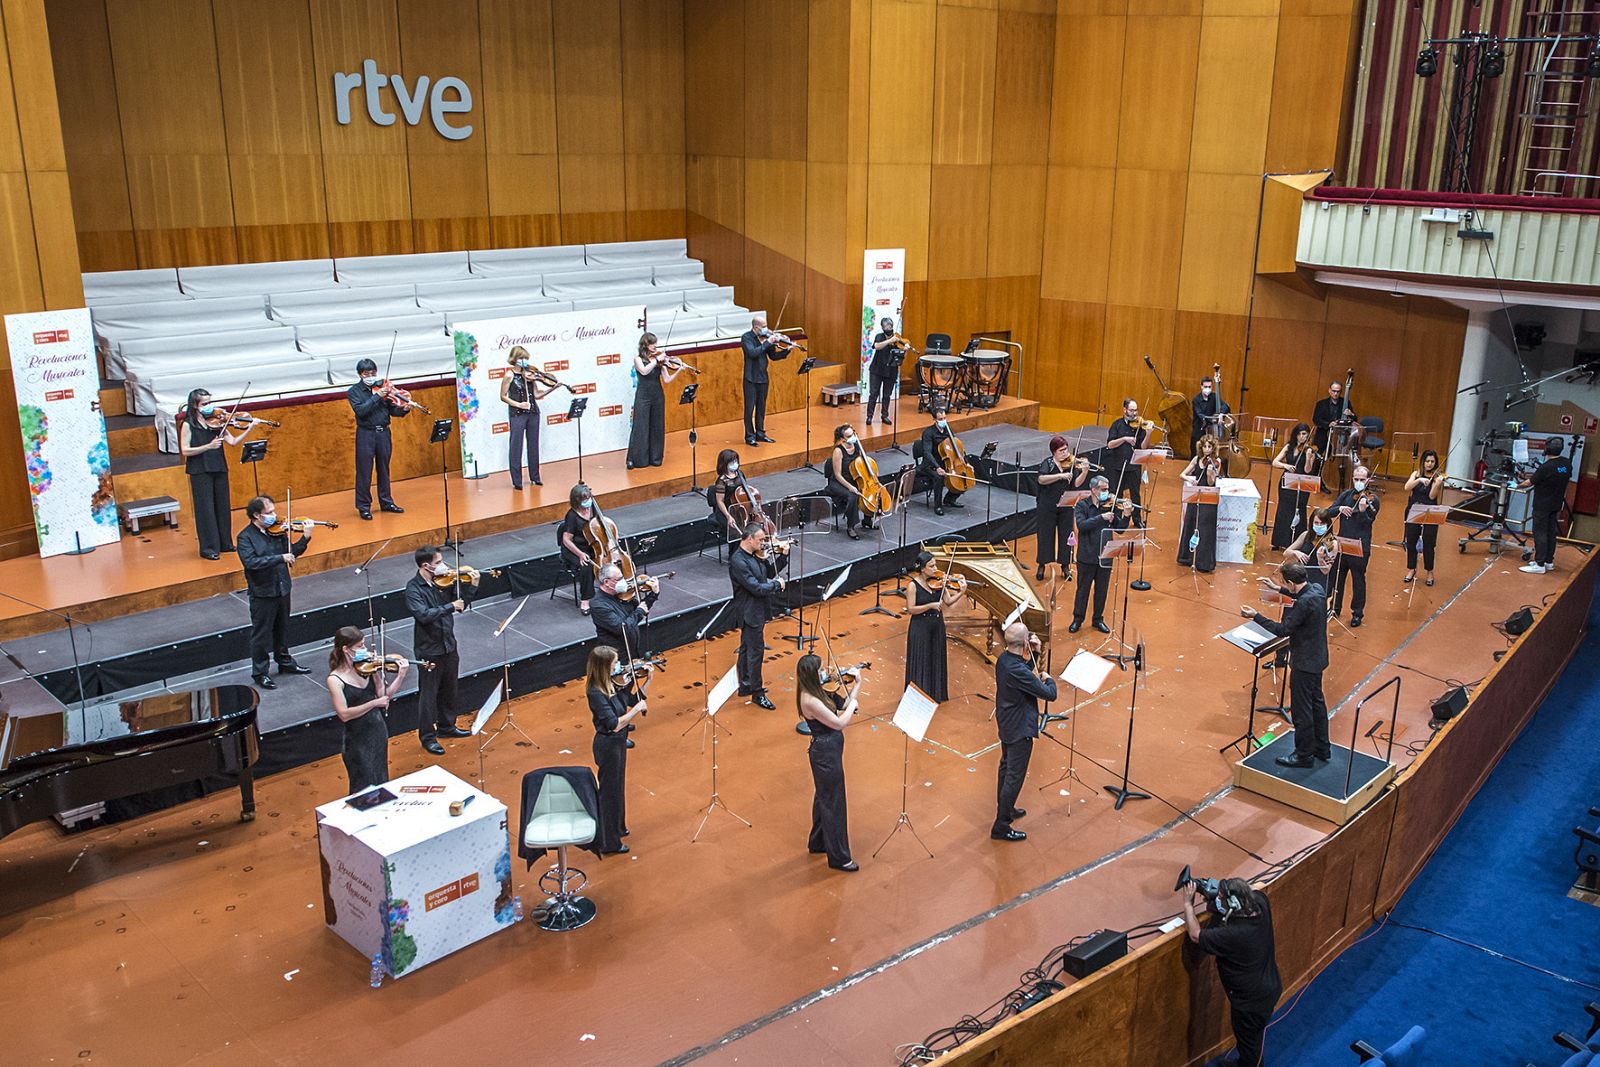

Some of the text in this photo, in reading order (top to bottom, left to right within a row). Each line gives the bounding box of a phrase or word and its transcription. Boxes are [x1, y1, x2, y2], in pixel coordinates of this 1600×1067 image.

[333, 58, 474, 140] rtve
[496, 326, 615, 350] Revoluciones Musicales
[26, 353, 87, 369] Revoluciones
[27, 368, 86, 384] Musicales
[463, 879, 477, 889] rtve
[428, 885, 456, 900] orquesta
[434, 895, 449, 906] coro
